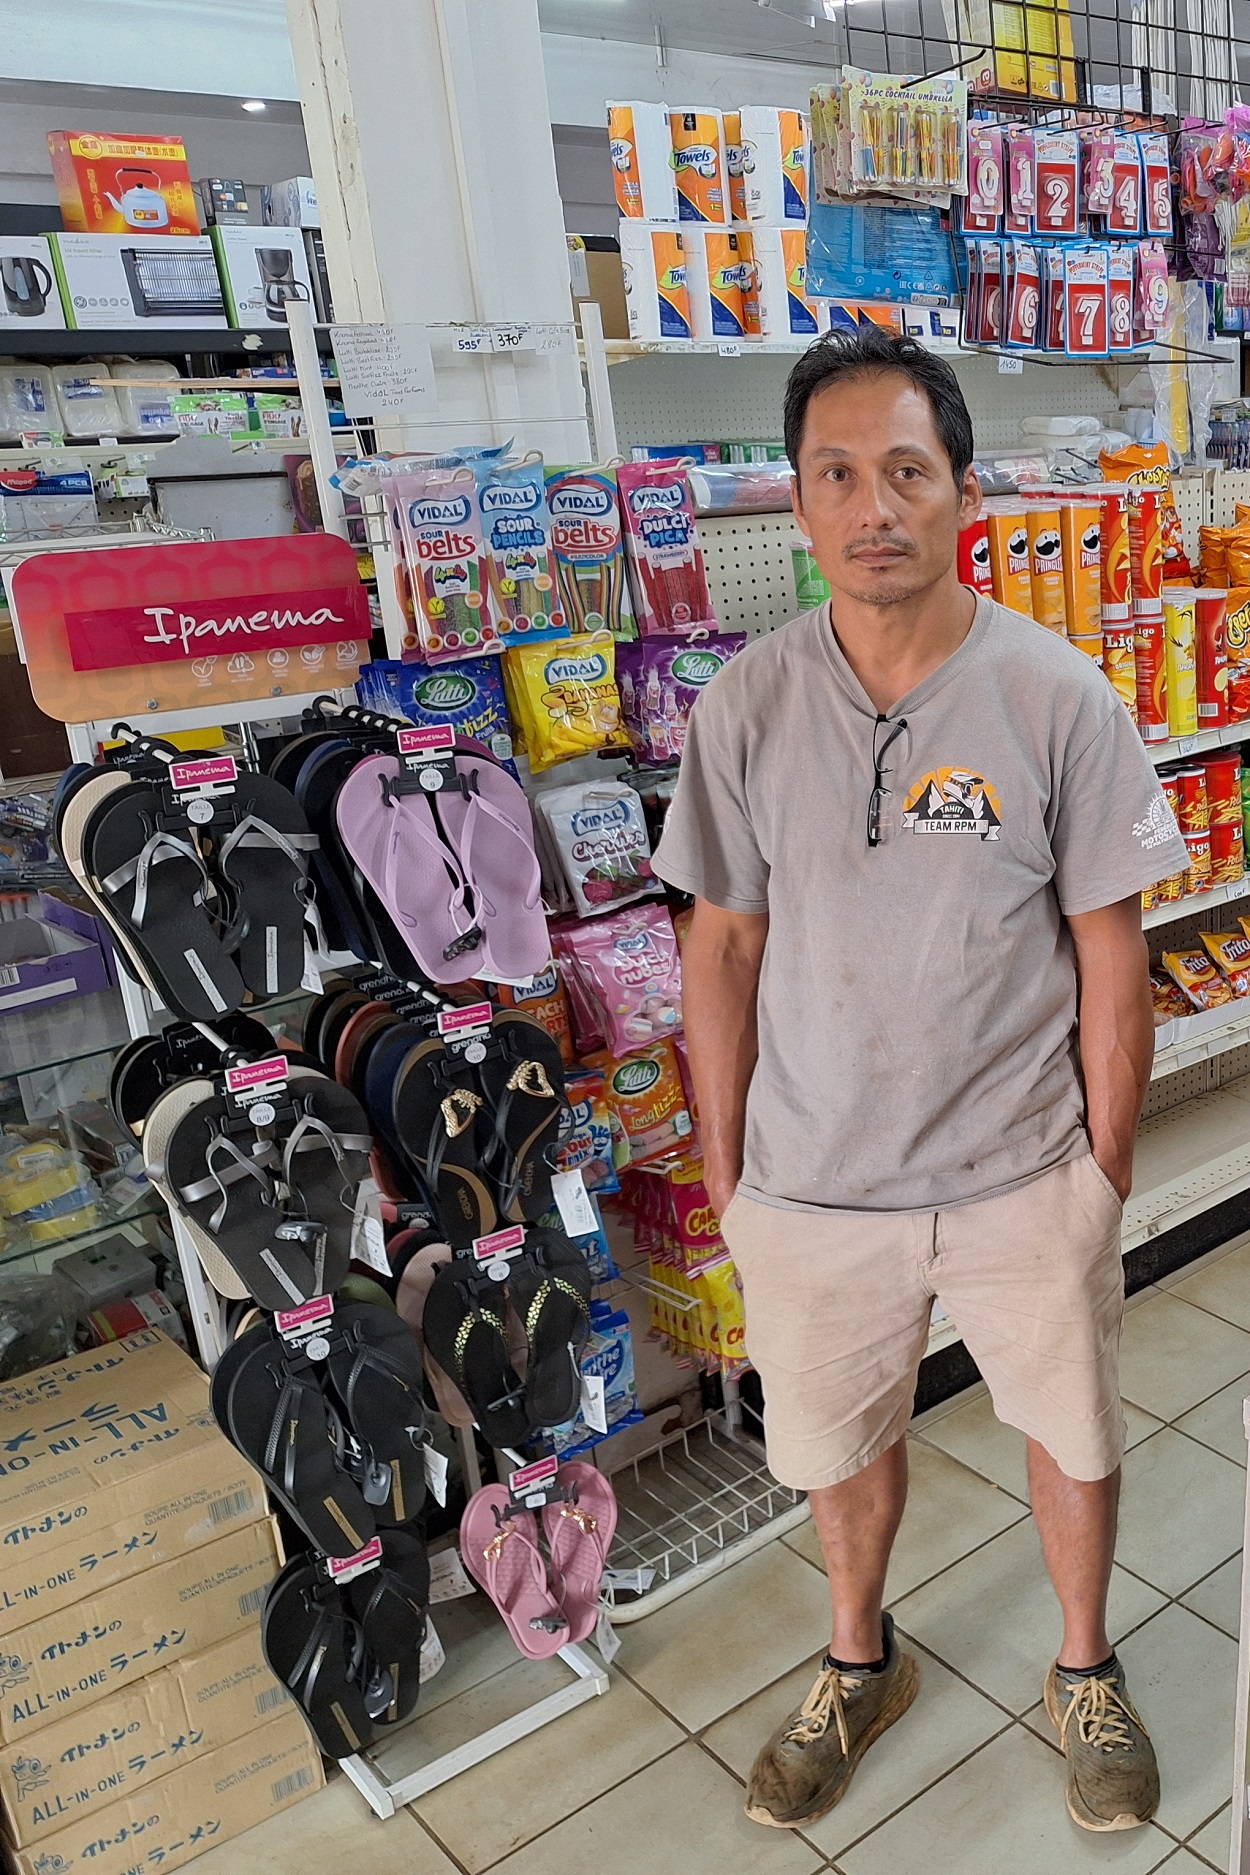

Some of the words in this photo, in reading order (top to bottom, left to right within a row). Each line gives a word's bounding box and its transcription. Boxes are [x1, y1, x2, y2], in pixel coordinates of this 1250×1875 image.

[864, 88, 883, 97] 36PC
[885, 90, 916, 100] COCKTAIL
[918, 93, 953, 103] UMBRELLA
[674, 149, 712, 166] Towels
[977, 158, 999, 200] 0
[1017, 158, 1034, 200] 1
[1096, 157, 1115, 198] 3
[1044, 176, 1070, 217] 2
[1116, 176, 1137, 217] 4
[1154, 179, 1171, 219] 5
[1148, 276, 1169, 315] 9
[1018, 286, 1039, 329] 6
[1075, 294, 1103, 336] 7
[1111, 293, 1130, 333] 8
[6, 477, 33, 487] Maped
[59, 479, 66, 487] 4
[67, 478, 88, 487] PCS
[486, 492, 533, 506] VIDAL
[556, 496, 604, 509] VIDAL
[636, 492, 679, 505] VIDAL
[417, 504, 463, 520] VIDAL
[497, 519, 534, 533] SOUR
[552, 520, 616, 546] belts
[558, 519, 582, 528] SOUR
[641, 514, 689, 535] DULCI
[416, 529, 476, 559] belts
[420, 530, 444, 541] SOUR
[493, 532, 545, 547] PENCILS
[650, 532, 688, 548] PICA
[654, 550, 686, 560] STRAWBERRY
[143, 606, 346, 655] Ipanema
[551, 658, 599, 679] VIDAL
[677, 654, 717, 681] Lutti
[422, 675, 472, 708] Lutti
[402, 731, 451, 746] Ipanema
[475, 724, 496, 742] Fruits
[176, 765, 231, 782] Ipanema
[429, 781, 436, 789] 9
[200, 812, 205, 820] 7
[578, 808, 623, 829] VIDAL
[939, 804, 965, 815] TAHITI
[924, 821, 952, 832] TEAM
[954, 821, 977, 832] RPM
[619, 964, 670, 986] nubes
[232, 1064, 284, 1083] Ipanema
[620, 1065, 654, 1091] Lutti
[79, 1530, 158, 1573] ラーメン
[109, 1628, 187, 1674] ラーメン
[12, 1669, 107, 1723] ALL-IN-ONE
[128, 1727, 204, 1774] ラーメン
[33, 1771, 126, 1826] ALL-IN-ONE
[148, 1818, 222, 1865] ラーメン
